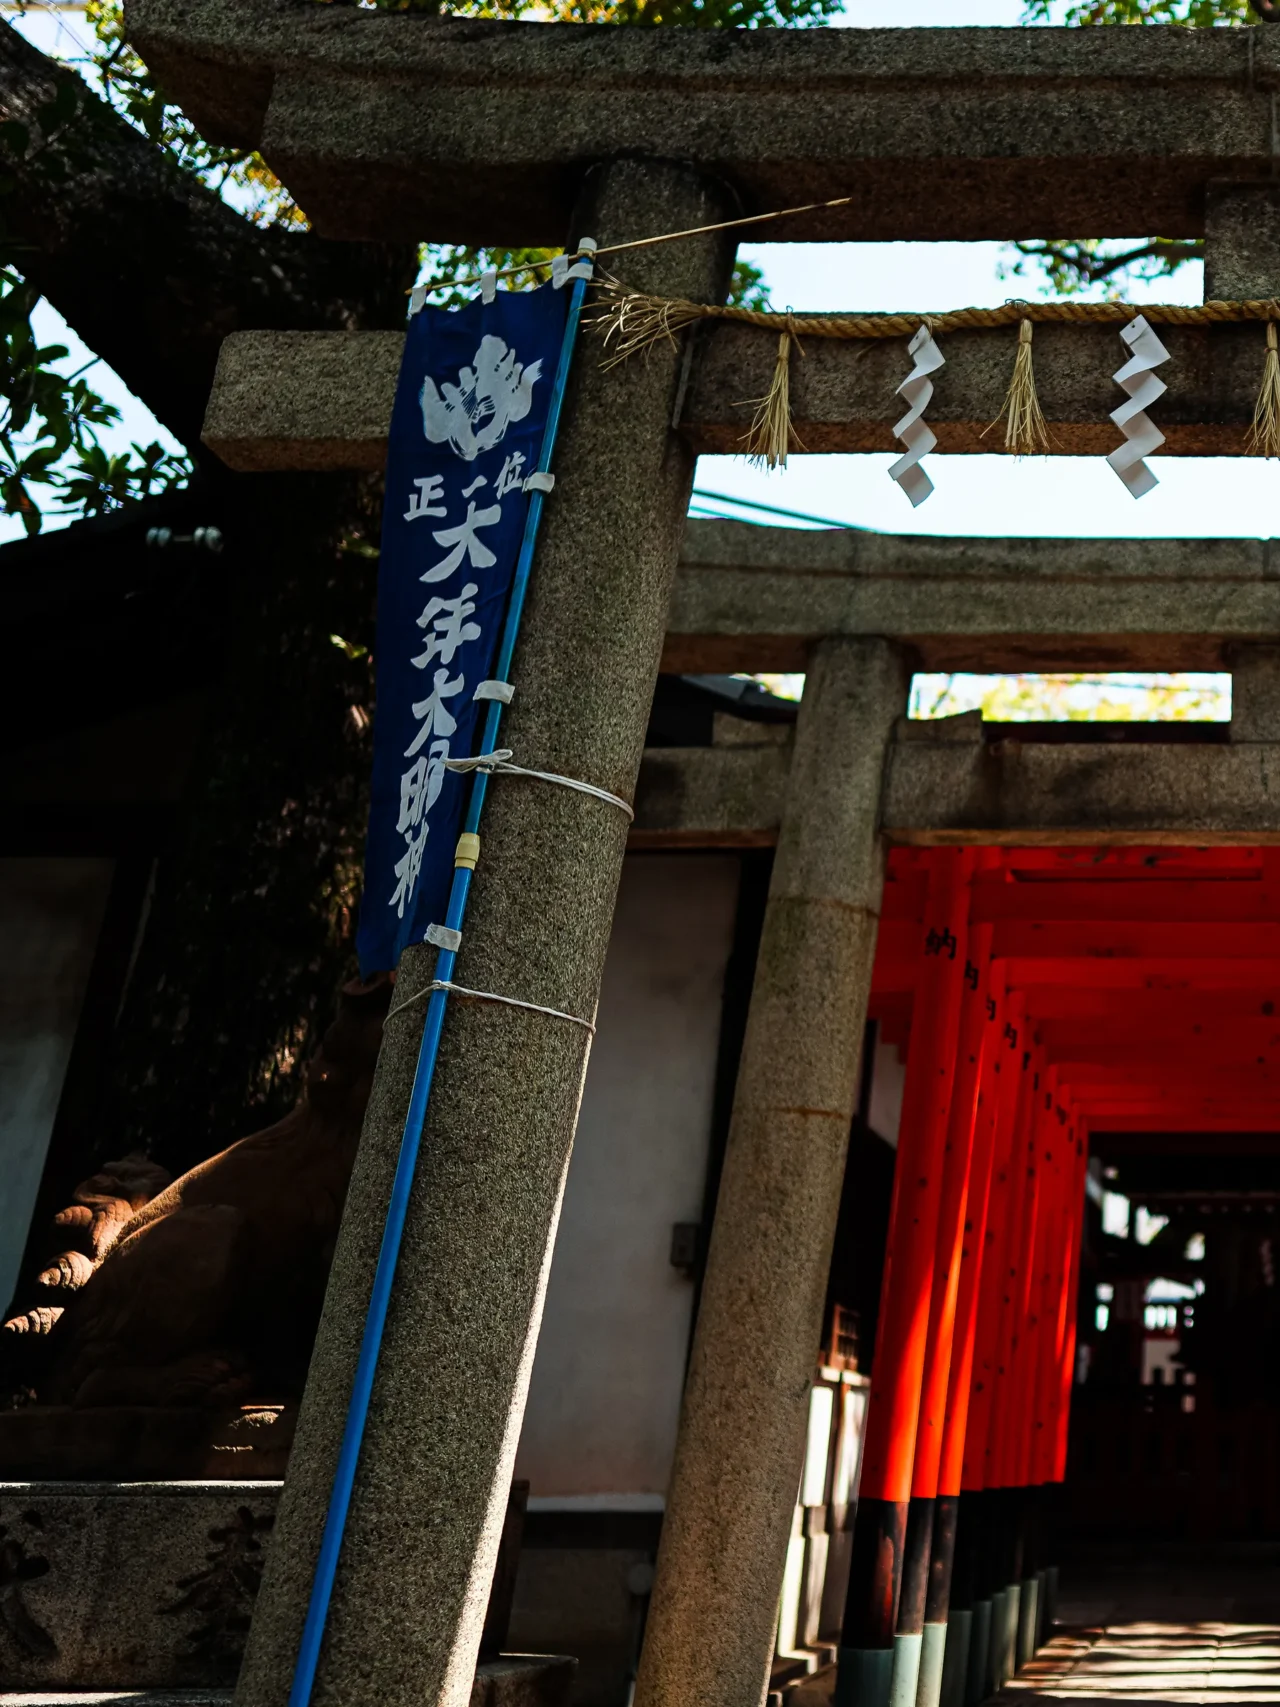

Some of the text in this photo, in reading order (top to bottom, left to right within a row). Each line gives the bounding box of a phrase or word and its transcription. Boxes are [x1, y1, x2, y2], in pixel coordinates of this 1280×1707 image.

[403, 451, 526, 522] 正一位
[387, 500, 502, 918] 大年大明神
